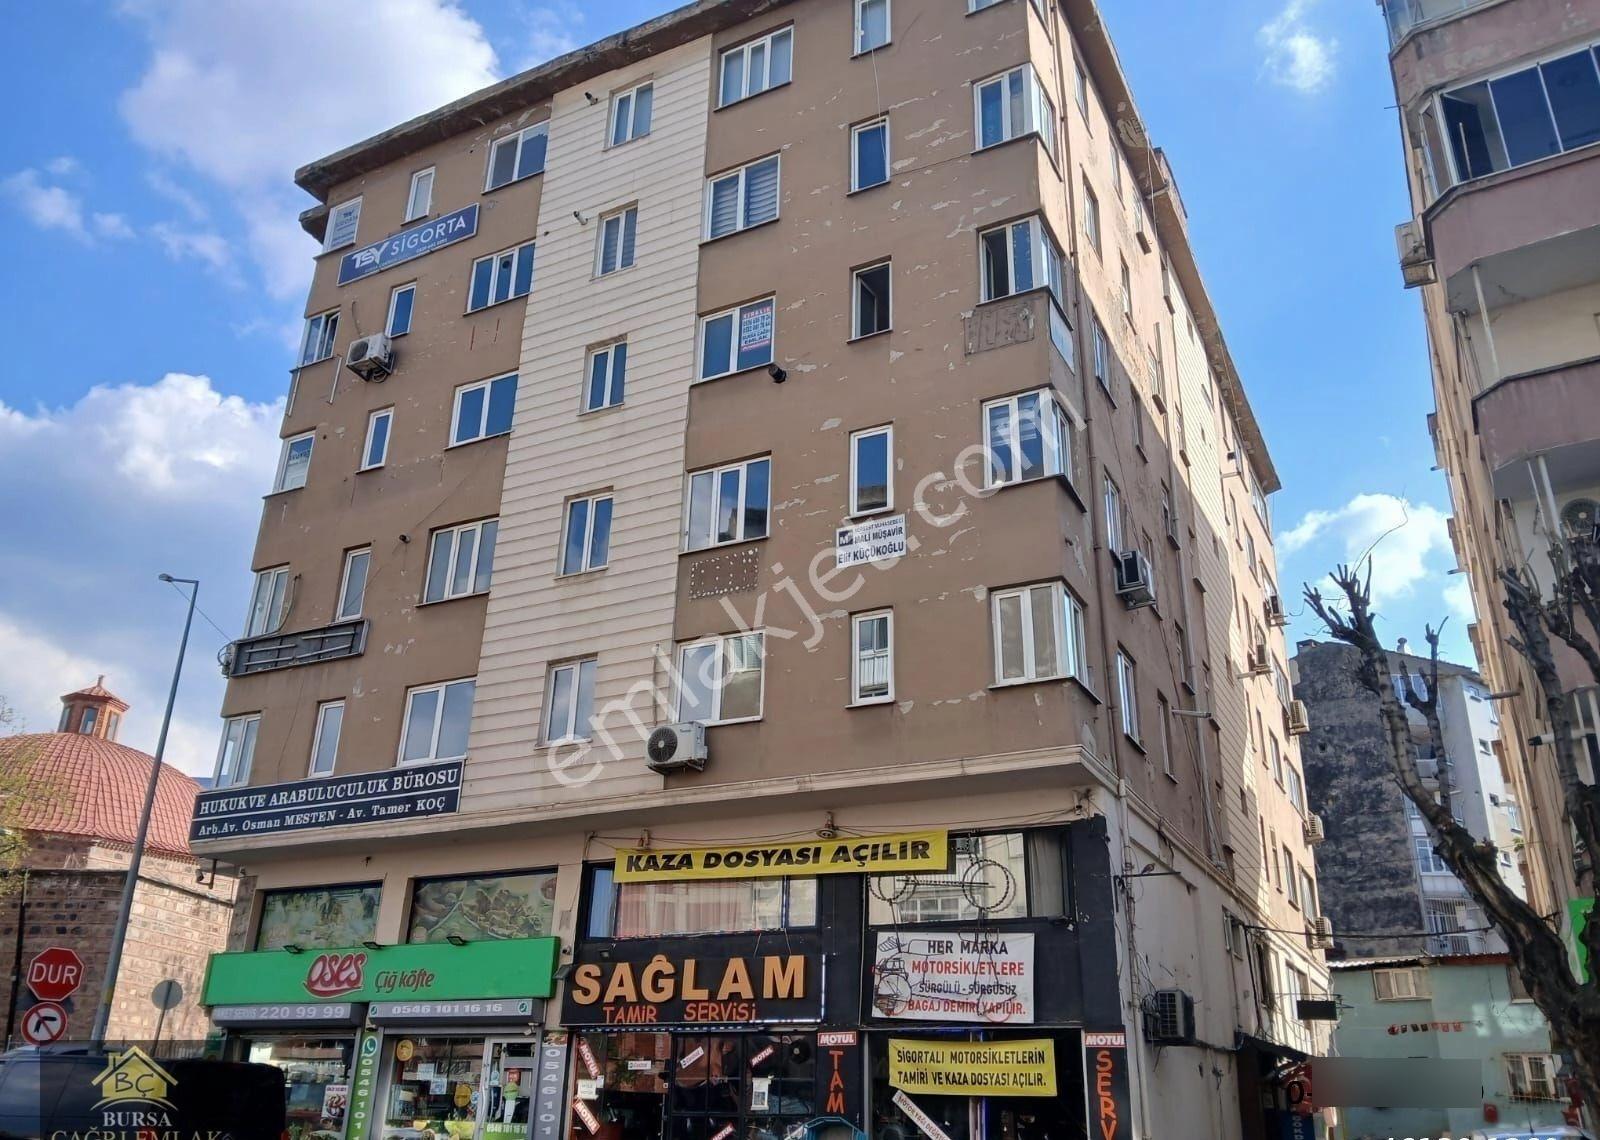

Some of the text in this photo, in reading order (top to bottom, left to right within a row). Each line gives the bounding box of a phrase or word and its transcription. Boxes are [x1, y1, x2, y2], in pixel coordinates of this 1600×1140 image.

[391, 216, 466, 256] SİGORTA
[873, 526, 904, 540] MÜŞAVİR
[853, 541, 904, 561] KÜÇÜKOĞLU
[269, 778, 389, 807] ARABULUCULUK
[392, 768, 458, 791] BÜROSU
[242, 819, 281, 832] Osman
[284, 810, 337, 826] MESTEN
[347, 807, 366, 819] Av.
[371, 803, 412, 817] Tamer
[416, 796, 446, 812] KOÇ
[625, 840, 930, 873] KAZA DOSYASI AÇILIR
[927, 940, 1009, 955] HER MARKA
[31, 962, 77, 985] DUR
[911, 957, 1025, 976] MOTORSİKLETLERE
[400, 968, 435, 992] köfte
[571, 953, 806, 1005] SAĞLAM
[918, 980, 960, 995] SÜRGÜLÜ
[968, 981, 1017, 996] SÜRGÜSÜZ
[260, 1006, 290, 1019] 220
[295, 1006, 317, 1019] 99
[322, 1006, 345, 1018] 99
[391, 1004, 431, 1015] 0546
[434, 1004, 460, 1014] 101
[463, 1003, 481, 1014] 16
[907, 1000, 940, 1012] BAGAJ
[820, 1033, 854, 1044] MOTUL
[579, 1043, 599, 1077] MOTUL
[751, 1047, 774, 1067] MOTUL
[897, 1047, 1045, 1064] SİGORTALI MOTORSİKLETLERİN
[897, 1068, 1047, 1088] TAMİRİ VE KAZA DOSYASI AÇILIR.
[576, 1101, 597, 1132] MOTUL
